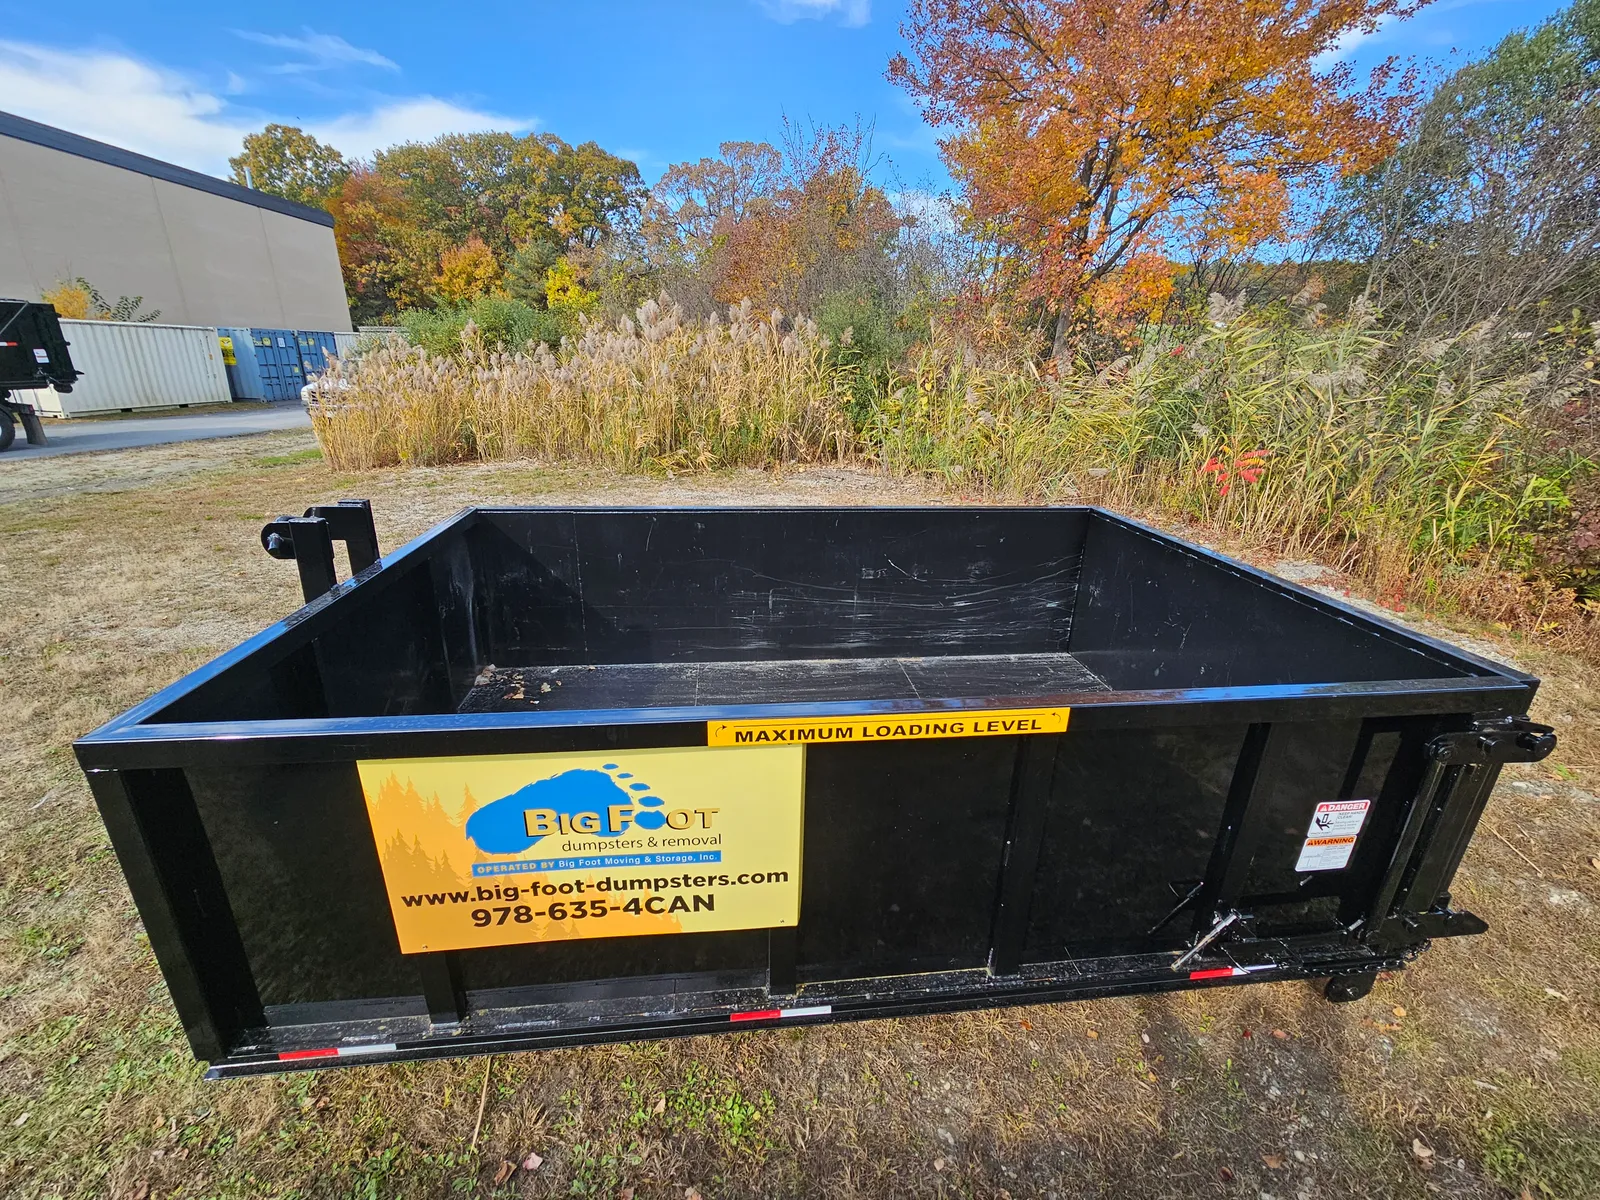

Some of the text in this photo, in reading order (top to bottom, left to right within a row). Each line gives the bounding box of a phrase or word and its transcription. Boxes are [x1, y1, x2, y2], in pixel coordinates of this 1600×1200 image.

[735, 719, 1042, 743] MAXIMUM LOADING LEVEL
[1328, 803, 1366, 811] DANGER
[523, 808, 601, 837] BIG
[562, 833, 722, 852] dumpsters & removal
[1313, 837, 1354, 846] WARNING
[477, 853, 718, 874] OPERATED BY Big Foot Moving & Storage, Inc.
[401, 869, 789, 907] www.big-foot-dumpsters.com
[471, 894, 715, 927] 978-635-4CAN
